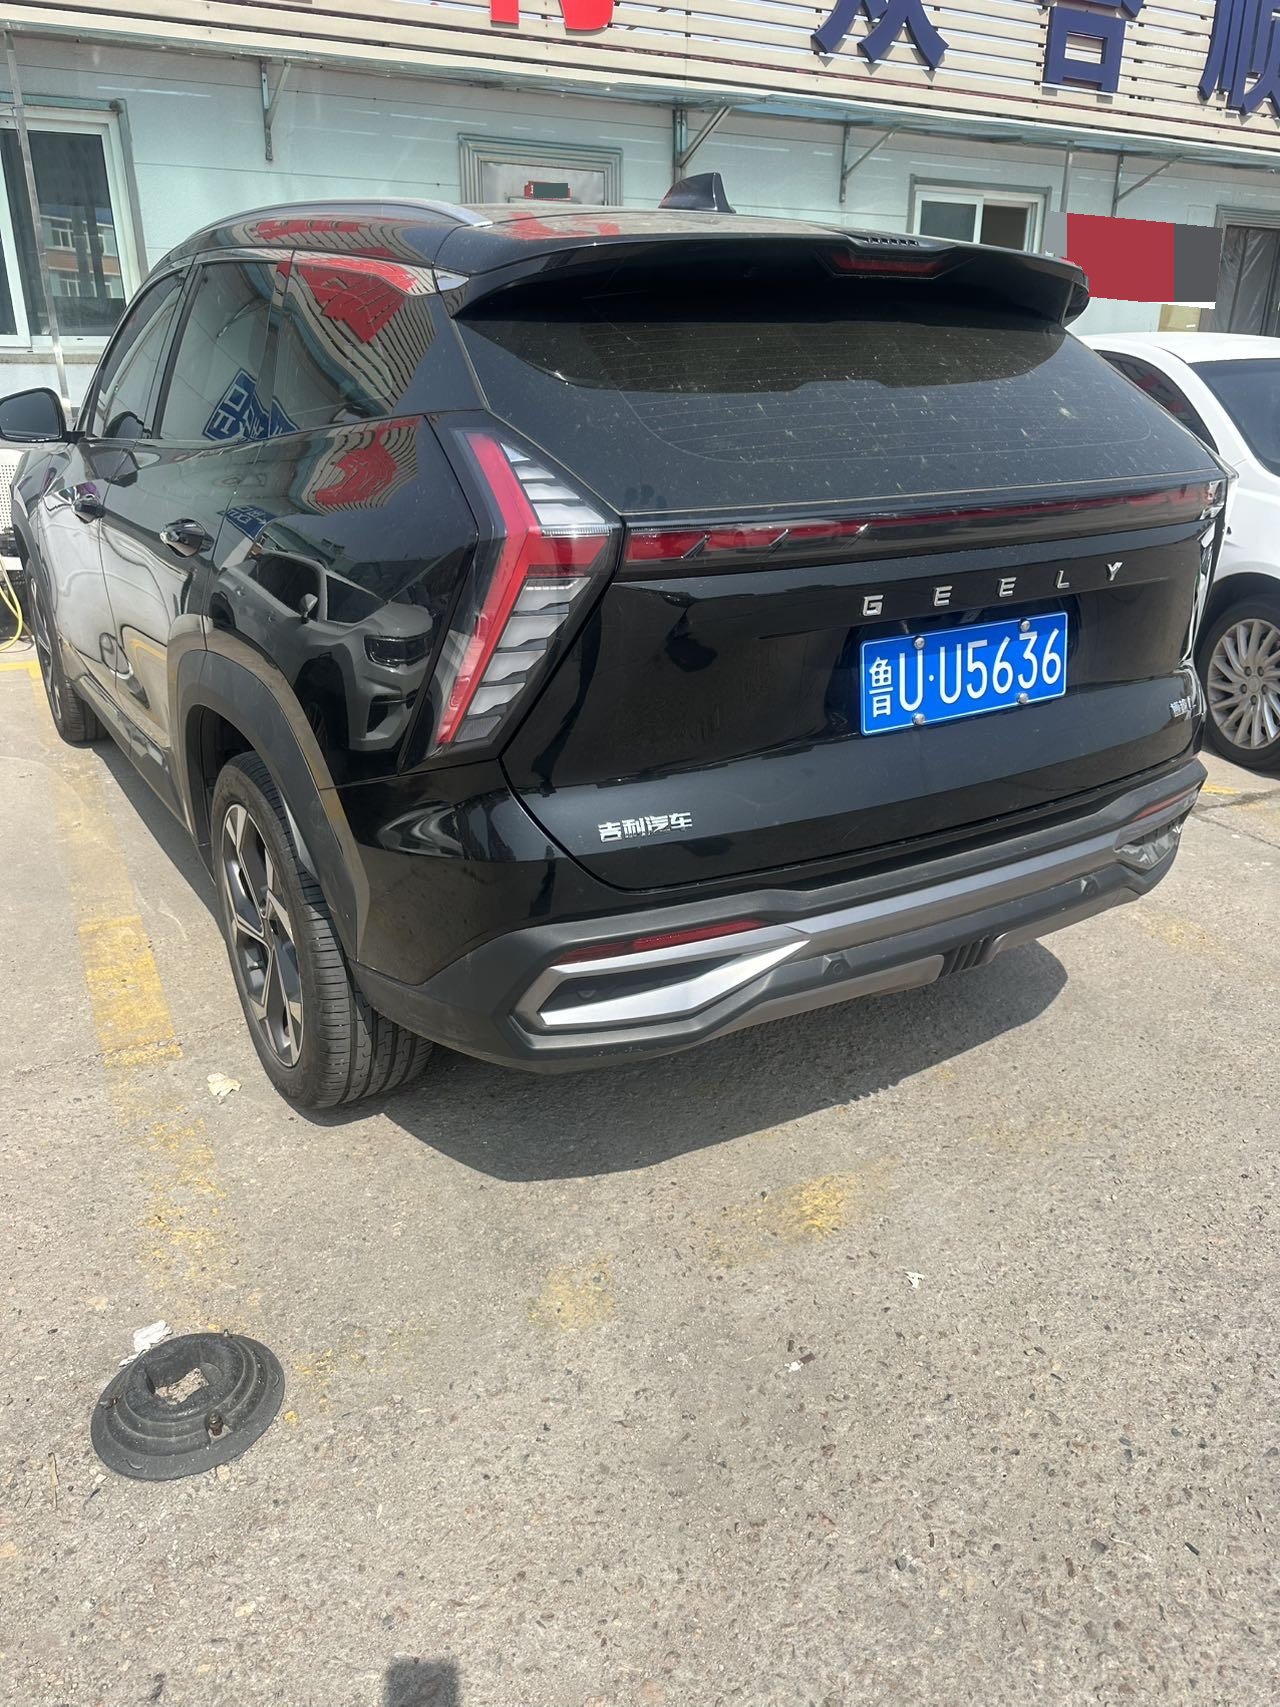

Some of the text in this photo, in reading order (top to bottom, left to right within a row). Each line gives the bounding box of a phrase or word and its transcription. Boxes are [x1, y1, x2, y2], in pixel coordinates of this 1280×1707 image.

[862, 561, 1122, 616] GEELY
[598, 812, 692, 842] 吉利汽车
